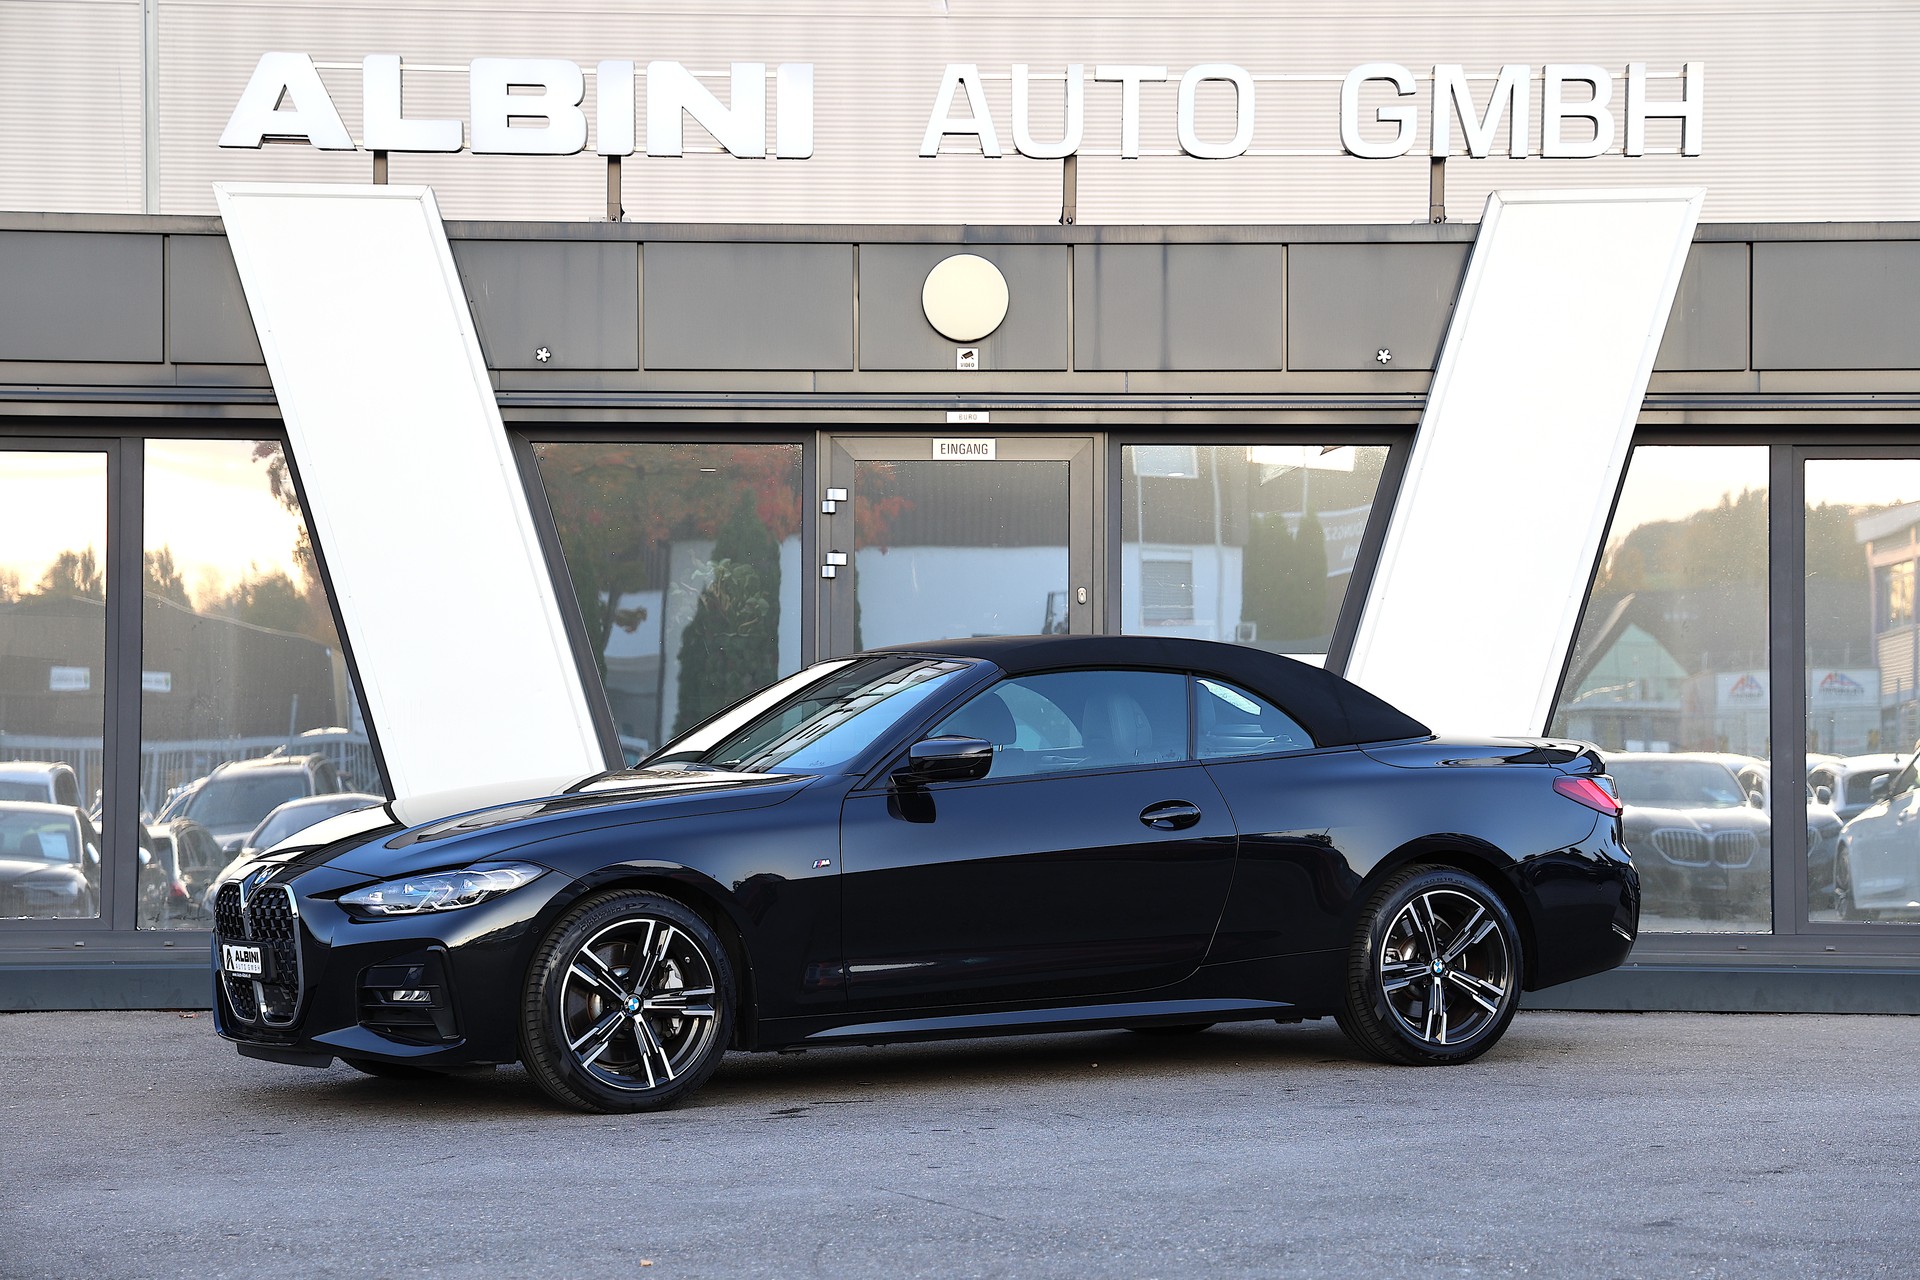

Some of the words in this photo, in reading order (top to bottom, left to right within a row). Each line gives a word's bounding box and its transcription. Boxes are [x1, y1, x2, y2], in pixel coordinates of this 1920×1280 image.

[219, 52, 814, 159] ALBINI
[919, 62, 1256, 159] AUTO
[1340, 61, 1704, 159] GMBH
[940, 443, 988, 455] EINGANG
[235, 950, 259, 963] ALBINI
